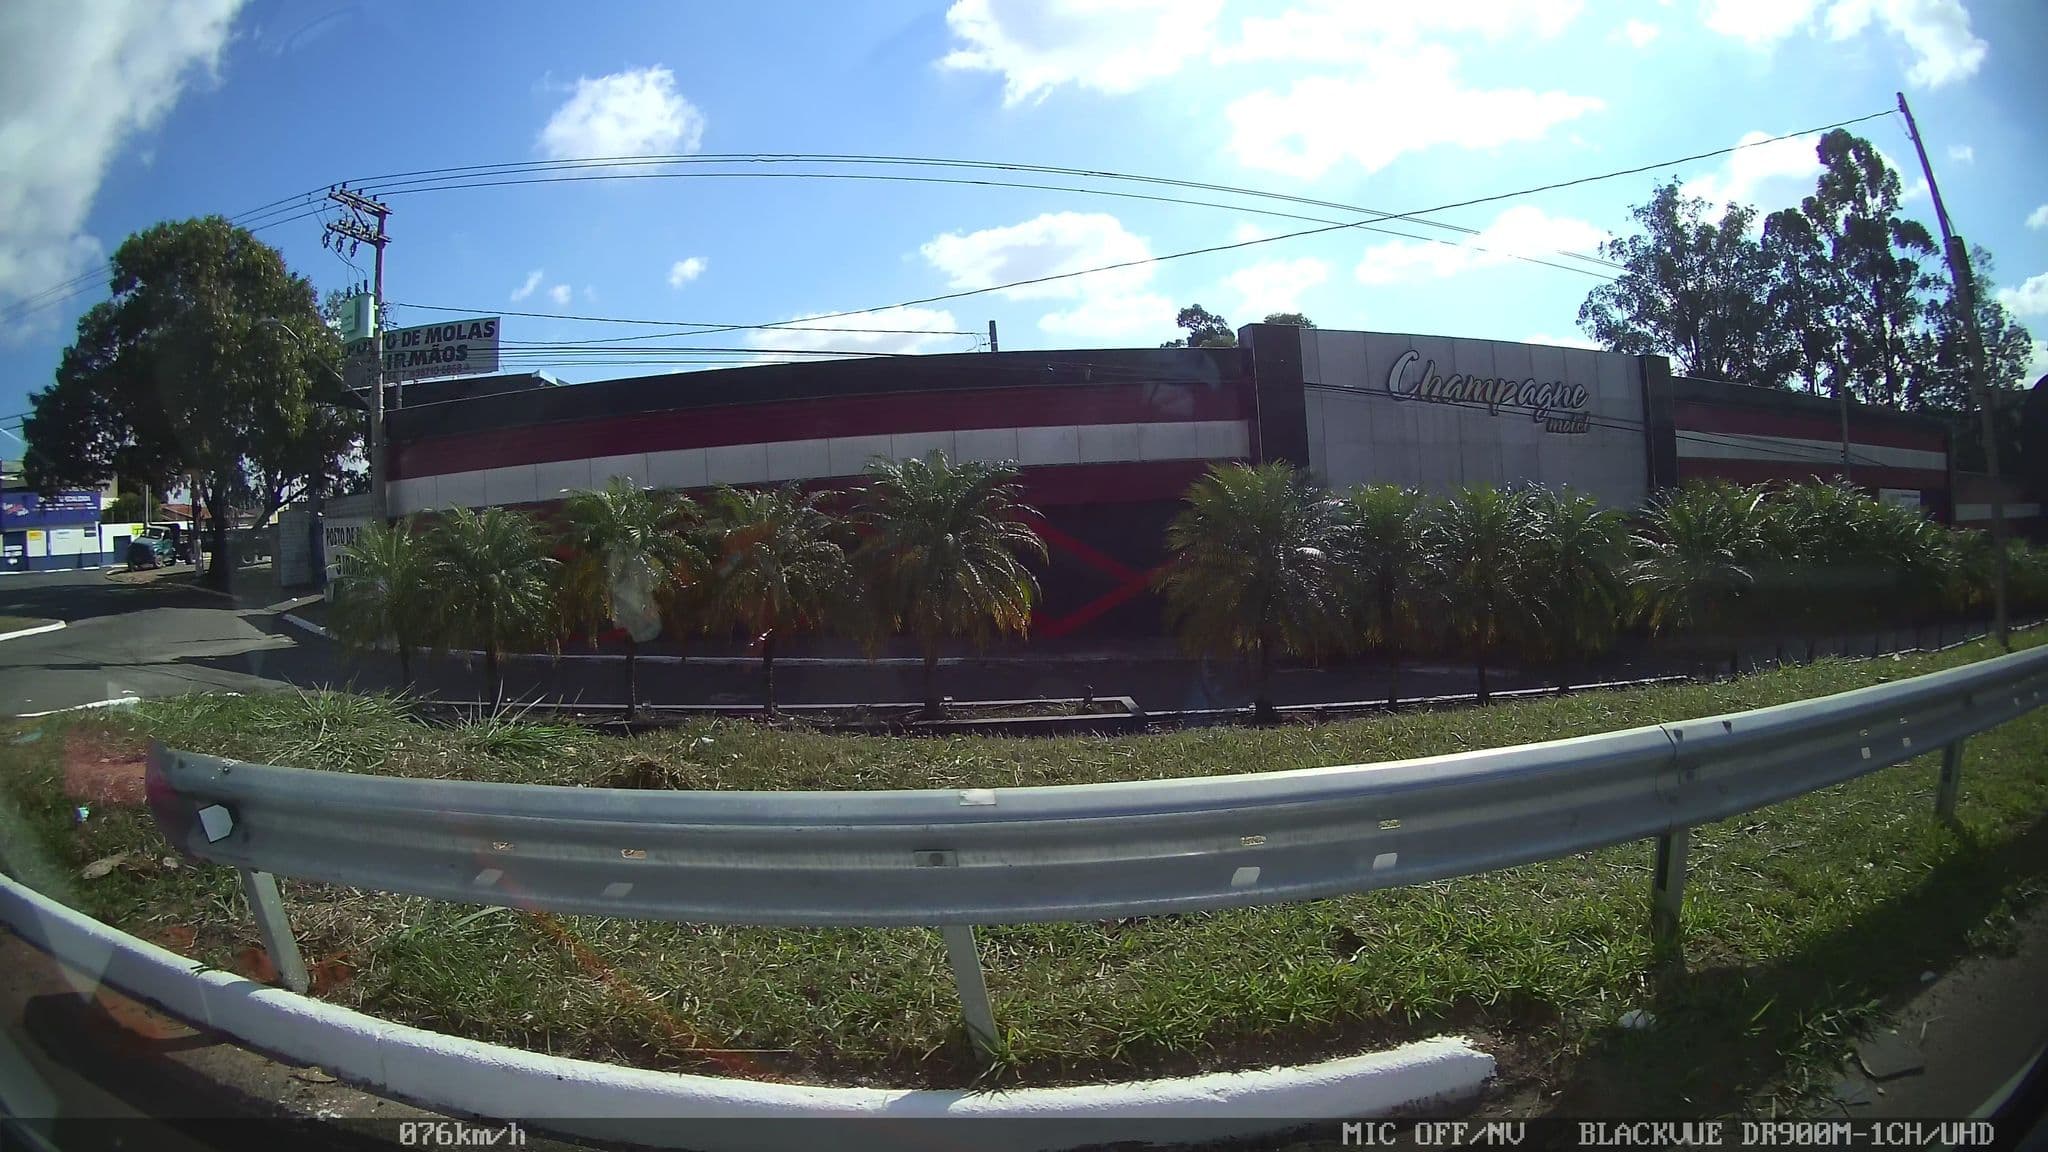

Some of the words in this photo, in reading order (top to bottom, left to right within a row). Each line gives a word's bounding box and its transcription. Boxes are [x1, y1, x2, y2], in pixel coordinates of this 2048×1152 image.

[402, 331, 421, 347] DE
[426, 321, 496, 344] MOLAS
[386, 344, 468, 370] IRMÃOS
[1388, 349, 1591, 423] Champagne
[326, 527, 345, 547] POSTO
